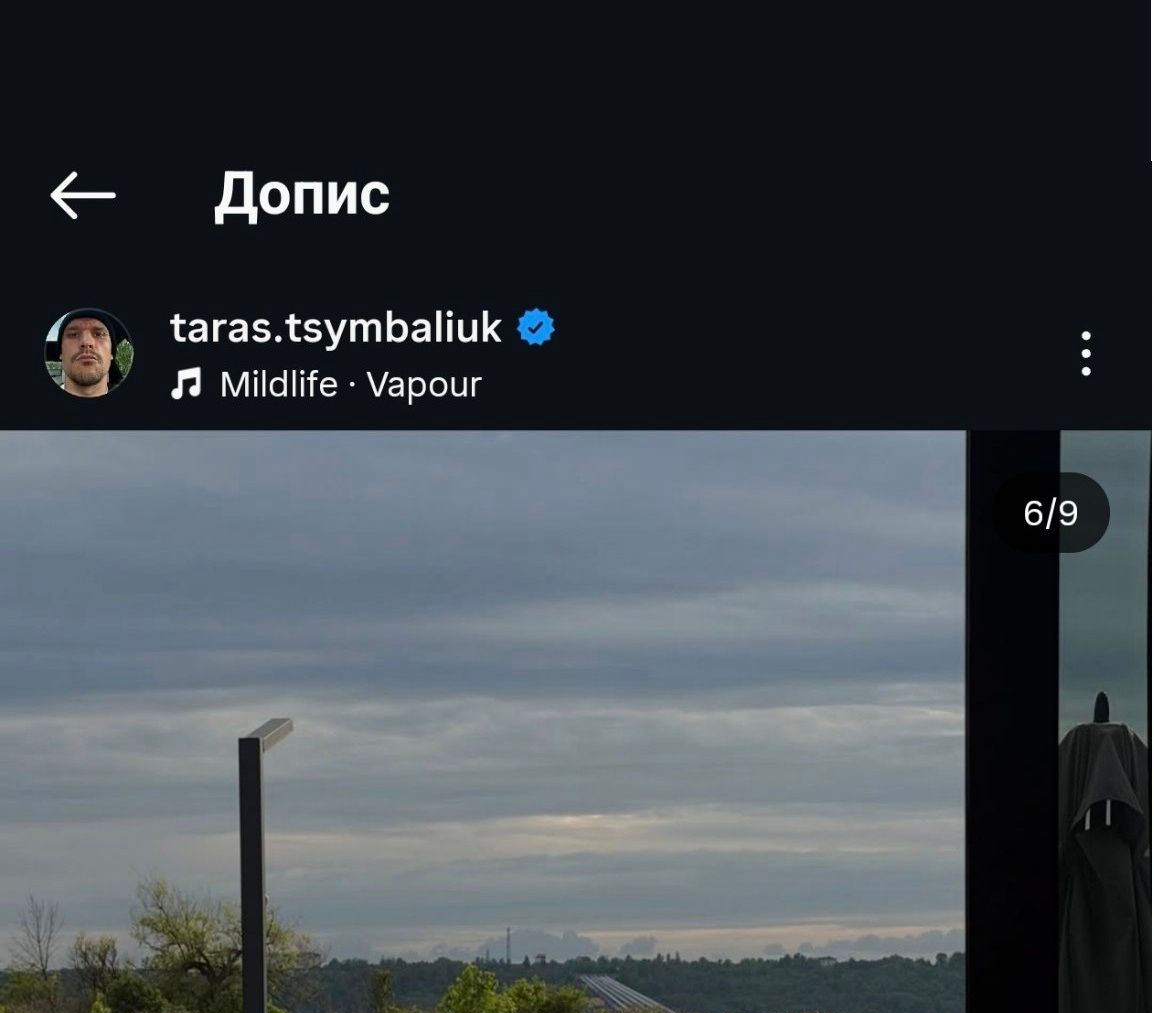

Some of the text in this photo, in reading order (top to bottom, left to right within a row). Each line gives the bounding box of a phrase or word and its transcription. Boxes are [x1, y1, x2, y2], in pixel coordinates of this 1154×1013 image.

[214, 170, 391, 225] Допис
[169, 309, 503, 352] taras.tsymbaliuk
[221, 369, 338, 398] Mildlife
[366, 371, 483, 406] Vapour
[1024, 496, 1079, 530] 6/9
